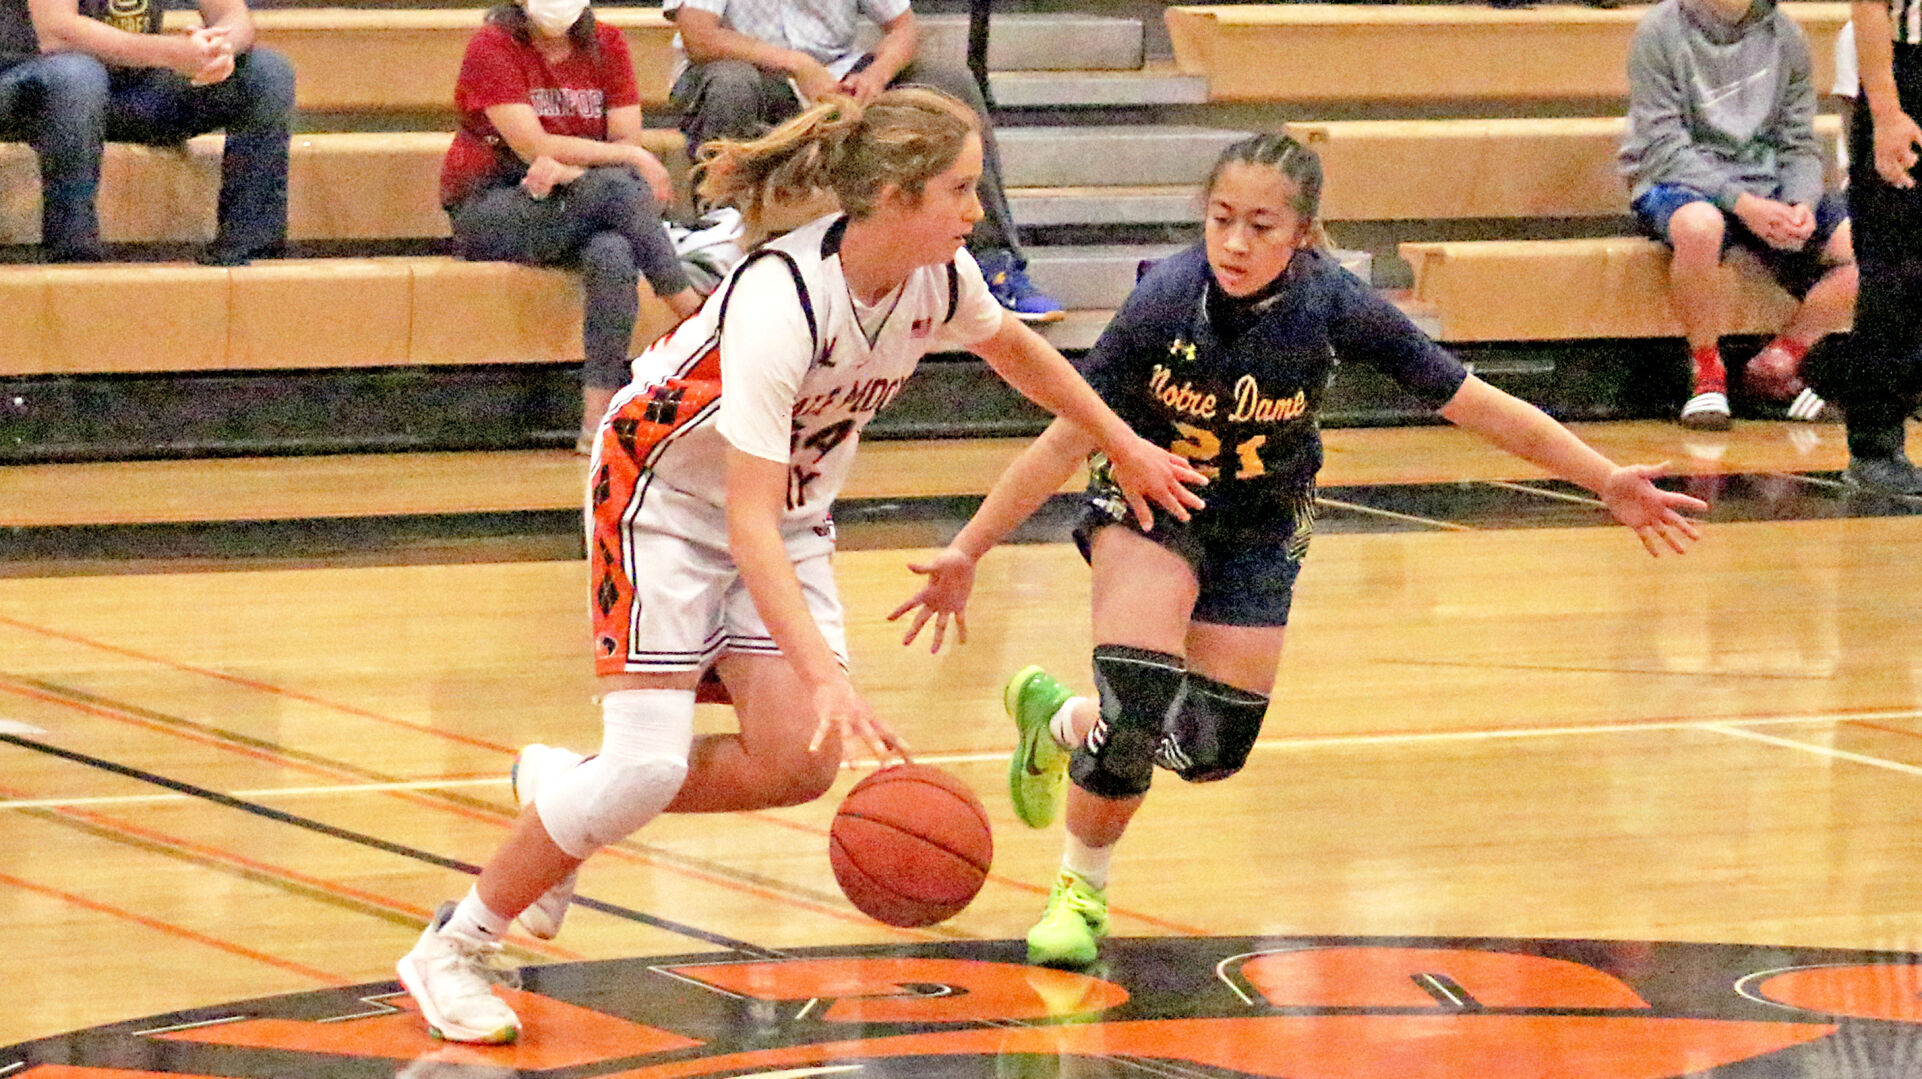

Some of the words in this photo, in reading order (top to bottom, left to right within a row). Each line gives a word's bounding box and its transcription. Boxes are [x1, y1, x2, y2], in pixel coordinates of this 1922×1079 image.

[1150, 363, 1216, 419] Notre
[1228, 373, 1306, 422] Dame
[1170, 421, 1267, 480] 21
